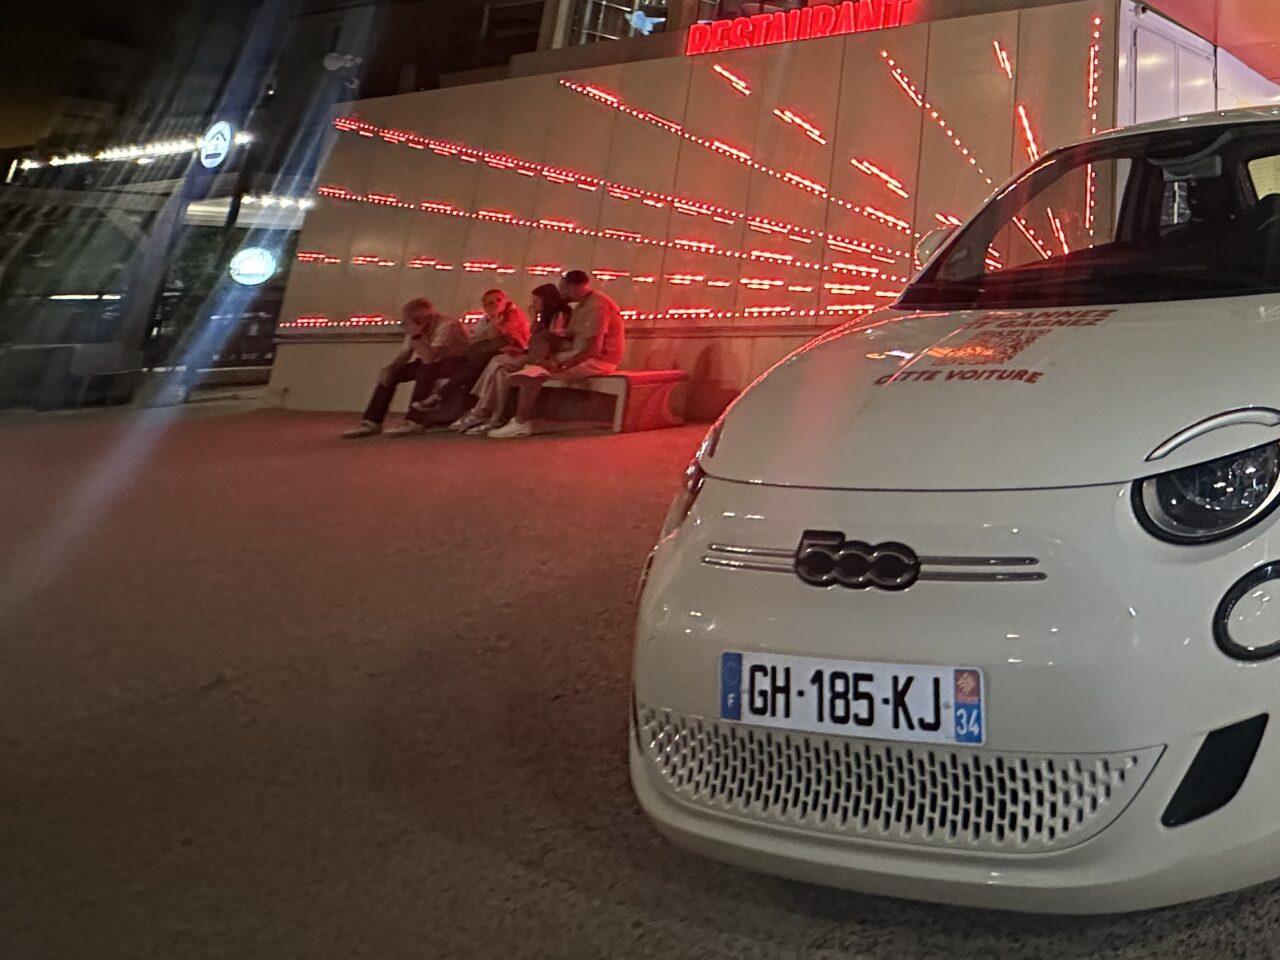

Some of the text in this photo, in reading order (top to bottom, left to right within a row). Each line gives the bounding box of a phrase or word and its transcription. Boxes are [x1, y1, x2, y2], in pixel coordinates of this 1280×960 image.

[944, 369, 1044, 385] VOITURE
[795, 530, 920, 591] 500
[749, 663, 941, 732] GH-185-KJ
[956, 708, 980, 736] 34
